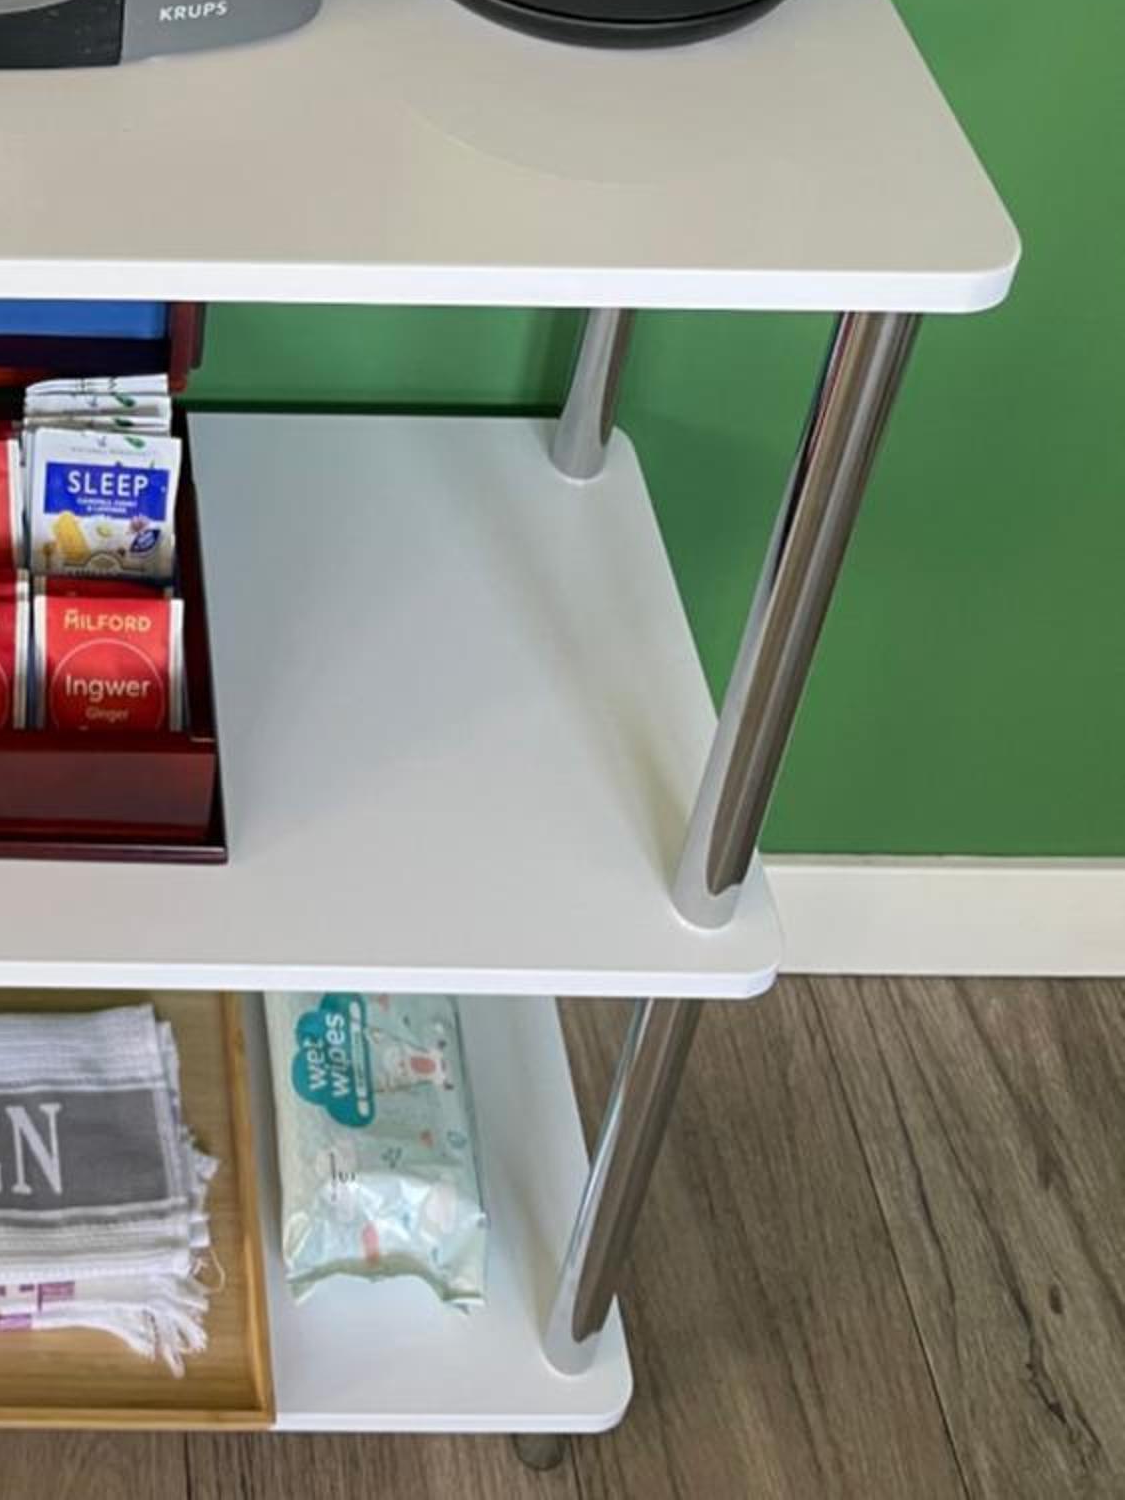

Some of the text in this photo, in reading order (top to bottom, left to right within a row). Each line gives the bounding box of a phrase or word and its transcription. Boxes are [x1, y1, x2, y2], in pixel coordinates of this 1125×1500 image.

[159, 0, 227, 21] KRUPS
[67, 469, 149, 498] SLEEP
[64, 609, 152, 633] MILFORD
[65, 675, 150, 702] Ingwer
[303, 1037, 327, 1092] wet
[325, 1012, 350, 1098] wipes
